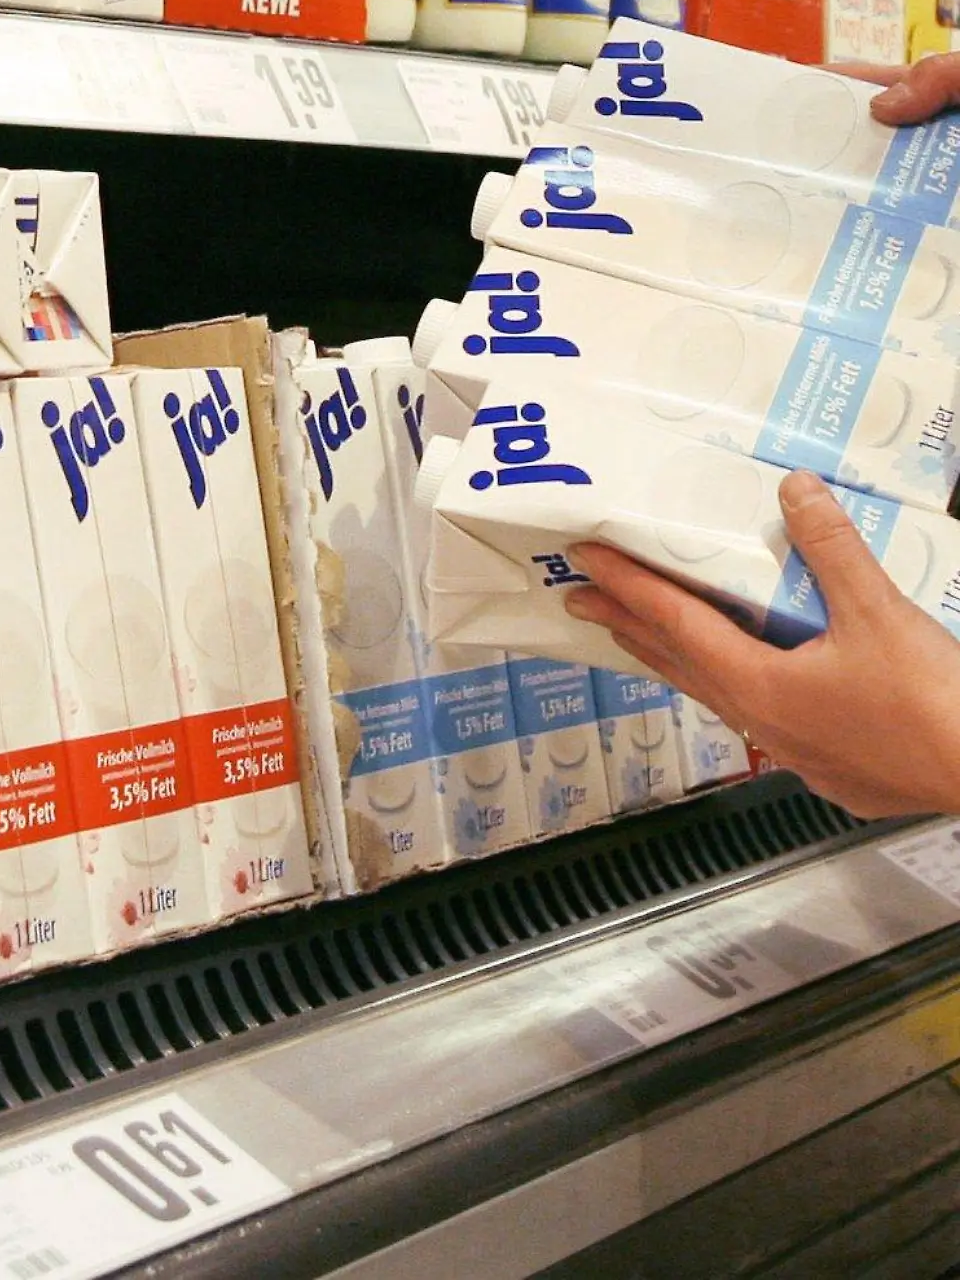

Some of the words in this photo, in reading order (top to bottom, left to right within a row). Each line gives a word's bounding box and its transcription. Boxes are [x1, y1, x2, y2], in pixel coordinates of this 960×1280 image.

[253, 53, 335, 130] 1.59
[593, 39, 705, 122] ja!
[520, 145, 634, 236] ja!
[858, 270, 891, 311] 1,5%
[875, 235, 906, 272] Fett
[461, 270, 581, 358] ja!
[301, 366, 368, 503] ja!
[815, 390, 849, 439] 1,5%
[833, 358, 863, 393] Fett
[921, 403, 956, 448] Liter
[40, 376, 126, 523] ja!
[161, 369, 241, 510] ja!
[468, 402, 594, 492] ja!
[96, 749, 133, 769] Frische
[109, 784, 150, 812] 3,5%
[150, 777, 177, 801] Fett
[222, 759, 261, 785] 3,5%
[261, 752, 285, 774] Fett
[27, 801, 56, 827] Fett
[148, 885, 178, 914] Liter
[258, 855, 286, 883] Liter
[25, 916, 57, 946] Liter
[72, 1110, 232, 1223] 0.61
